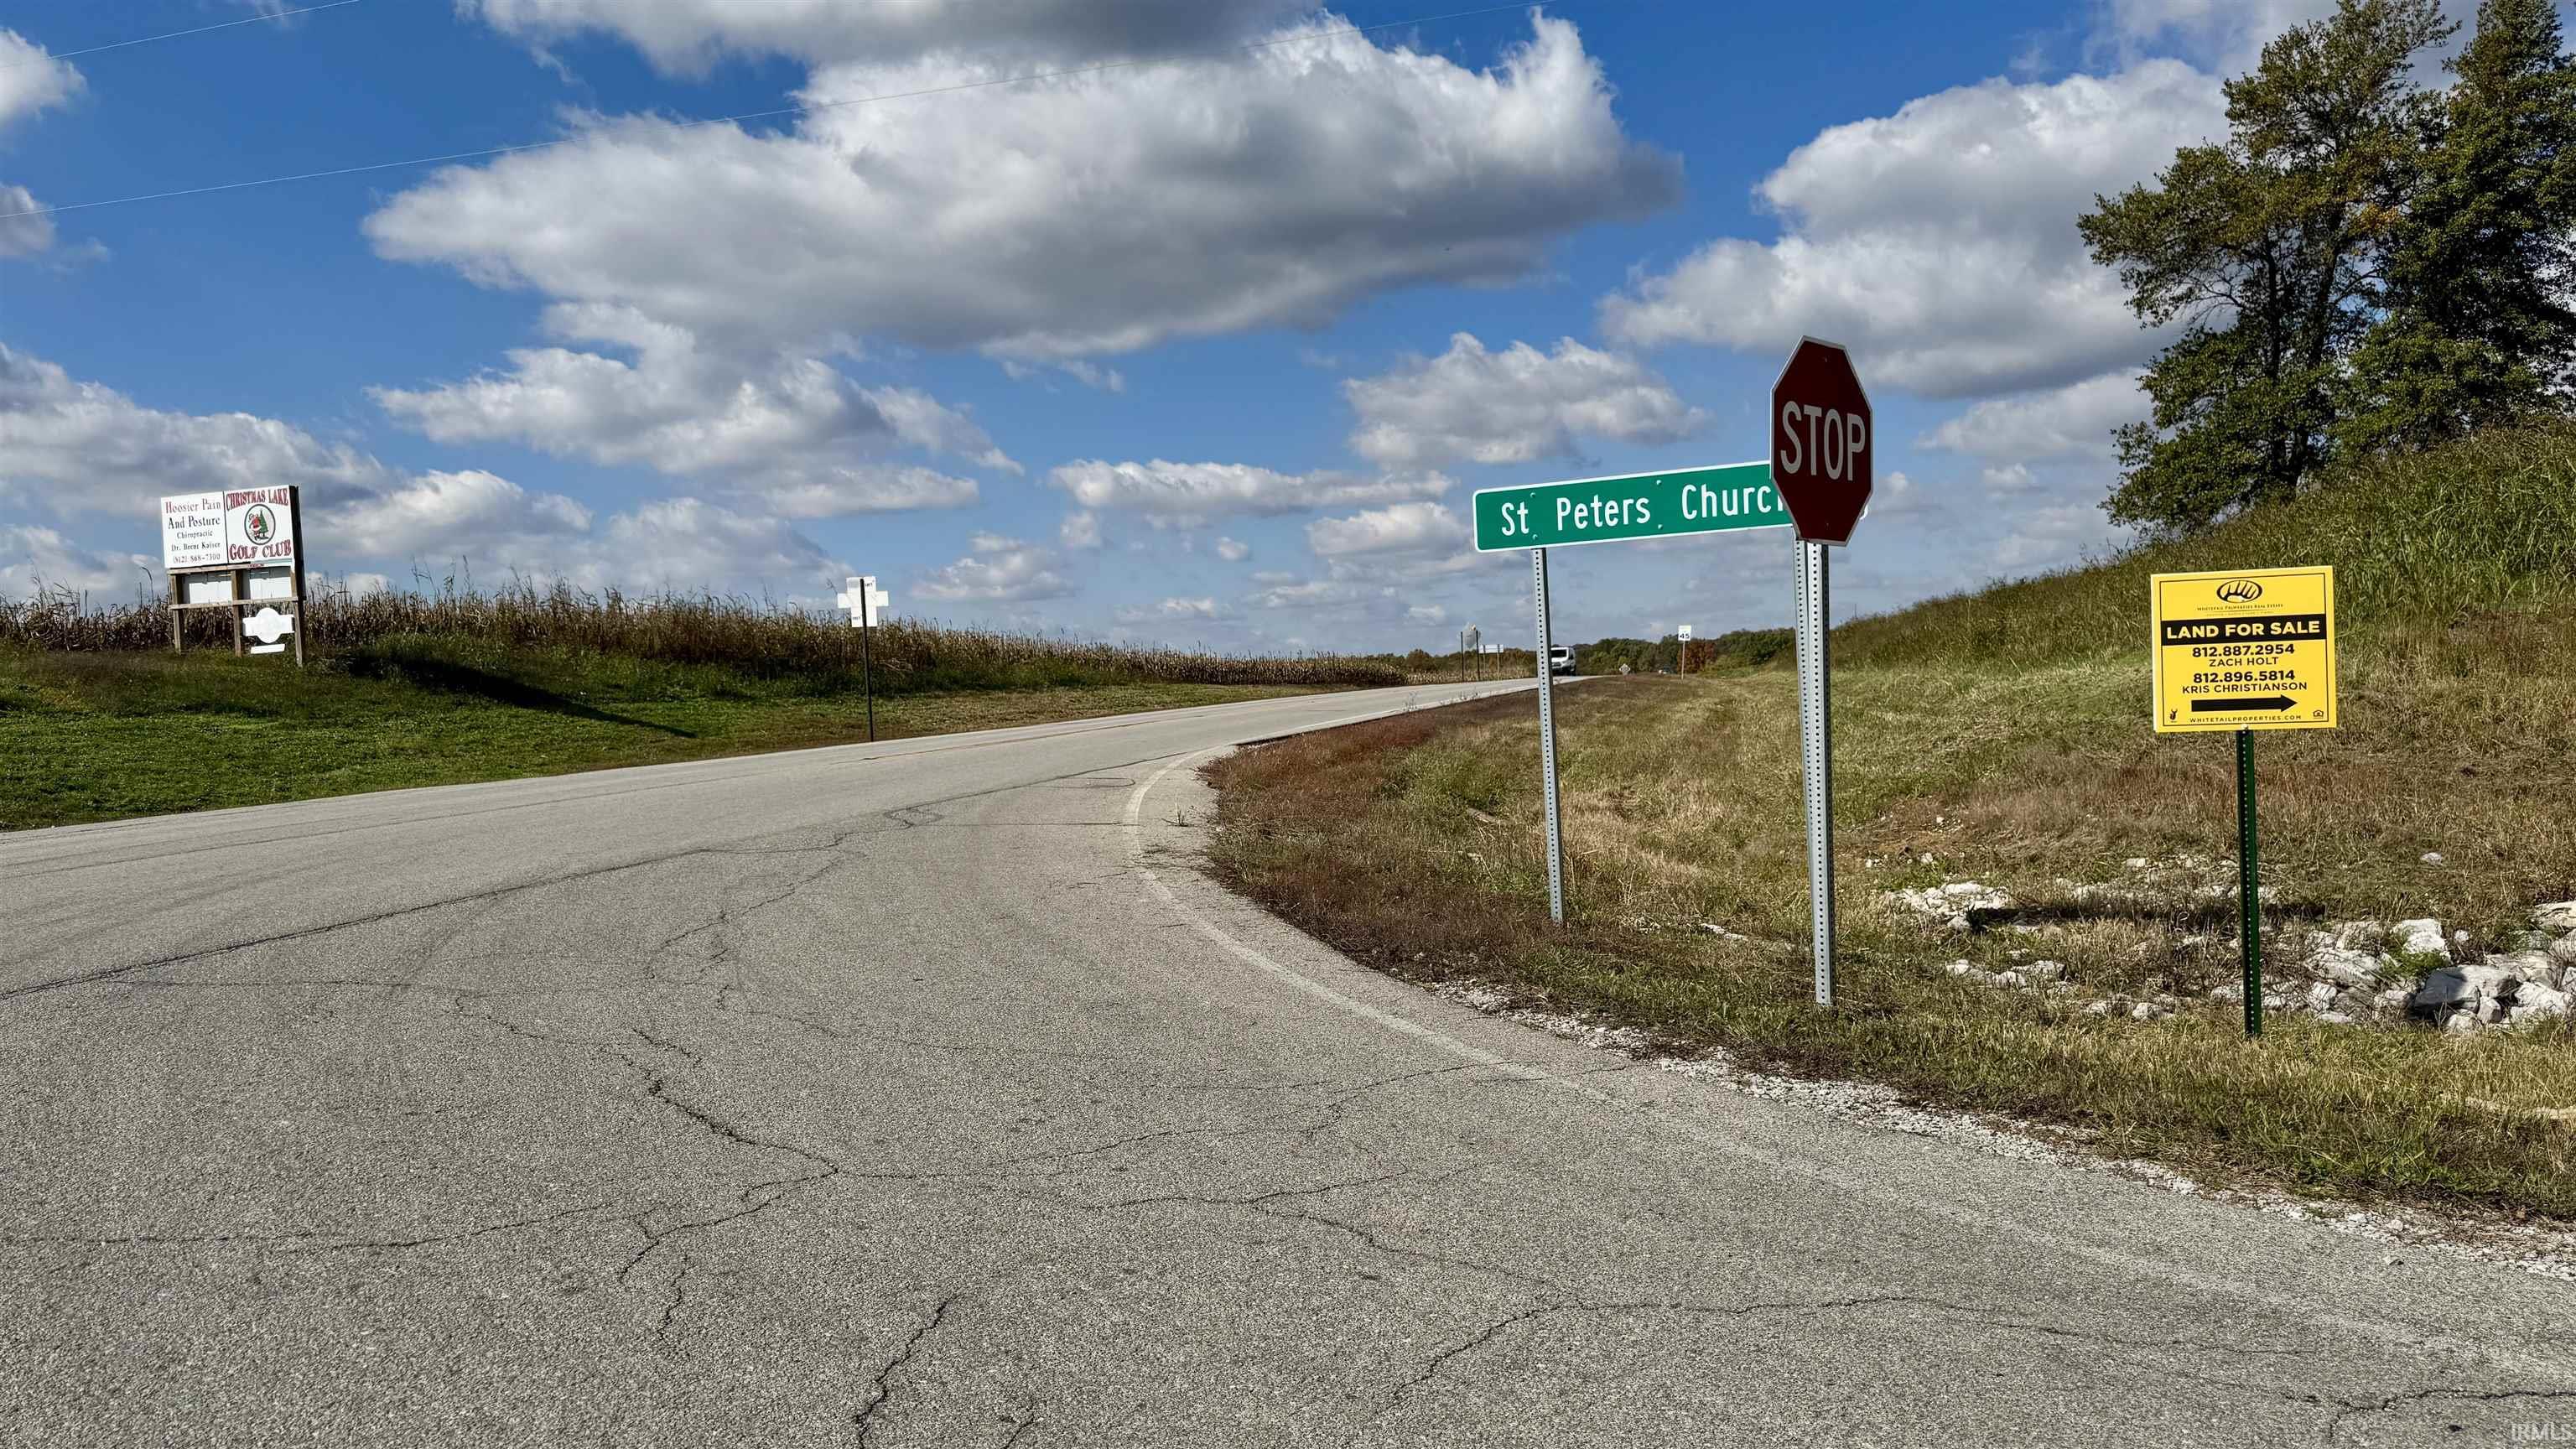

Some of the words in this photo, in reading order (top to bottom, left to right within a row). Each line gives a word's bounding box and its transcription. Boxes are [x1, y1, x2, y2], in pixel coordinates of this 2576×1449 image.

[1780, 400, 1866, 481] STOP
[165, 501, 199, 514] Hoosier
[202, 497, 221, 510] Pain
[226, 490, 266, 512] CHRISTMAS
[267, 488, 288, 506] LAKE
[1500, 499, 1530, 537] St
[1555, 493, 1651, 532] Peters
[1680, 482, 1784, 520] Churc
[168, 516, 185, 529] And
[188, 515, 221, 528] Posture
[176, 530, 213, 539] Chiropractic
[171, 543, 181, 552] Dr.
[229, 543, 258, 560] GOLF
[262, 539, 292, 558] CLUB
[2167, 624, 2219, 639] LAND
[2225, 623, 2265, 637] FOR
[2270, 621, 2320, 636] SALE
[2192, 643, 2295, 657] 812.887.2954
[2209, 657, 2243, 667] ZACH
[2246, 657, 2279, 666] HOLT
[2193, 669, 2296, 683] 812.896.5814
[2182, 684, 2210, 694] KRIS
[2214, 682, 2308, 693] CHRISTIANSON
[2189, 714, 2302, 723] WHITETAILPROPERTIES.COM
